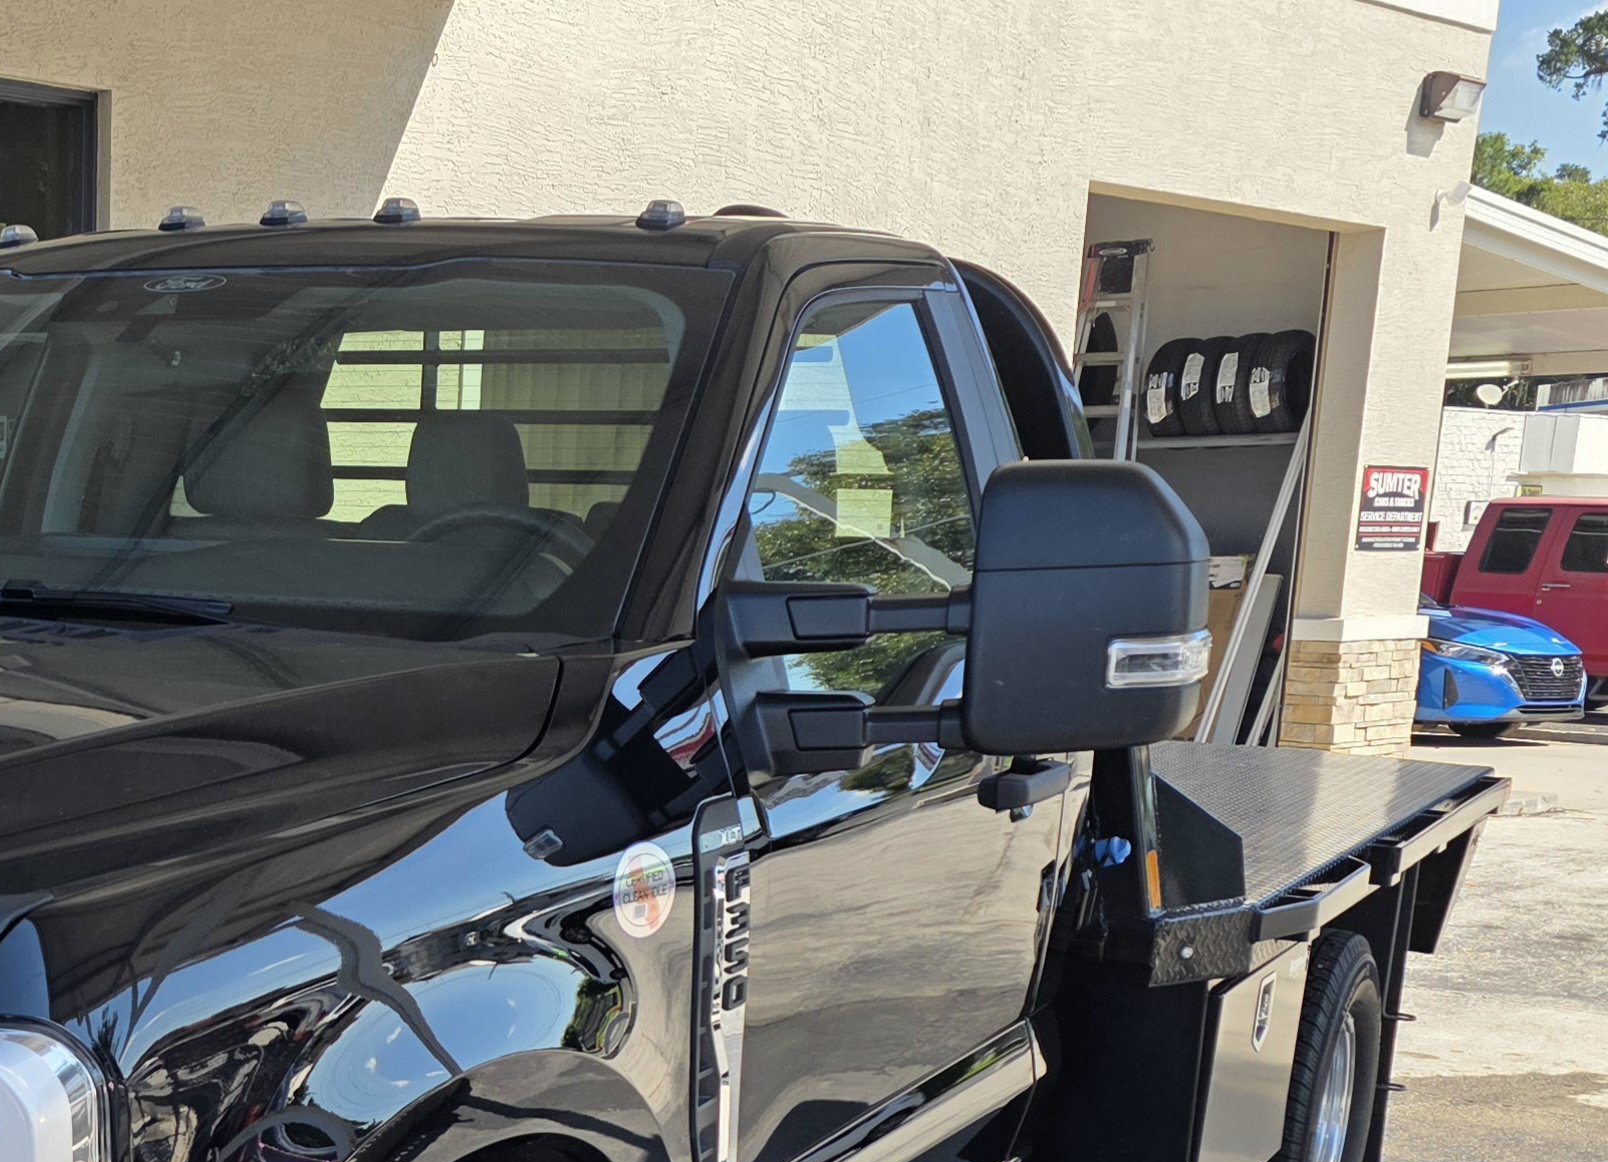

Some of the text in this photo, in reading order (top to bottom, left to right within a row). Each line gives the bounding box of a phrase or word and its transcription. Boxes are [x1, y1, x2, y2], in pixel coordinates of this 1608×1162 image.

[1367, 471, 1422, 500] SUMTER
[625, 869, 664, 888] CERTIFIED
[622, 888, 649, 905] CLEAN
[721, 862, 751, 1012] F350
